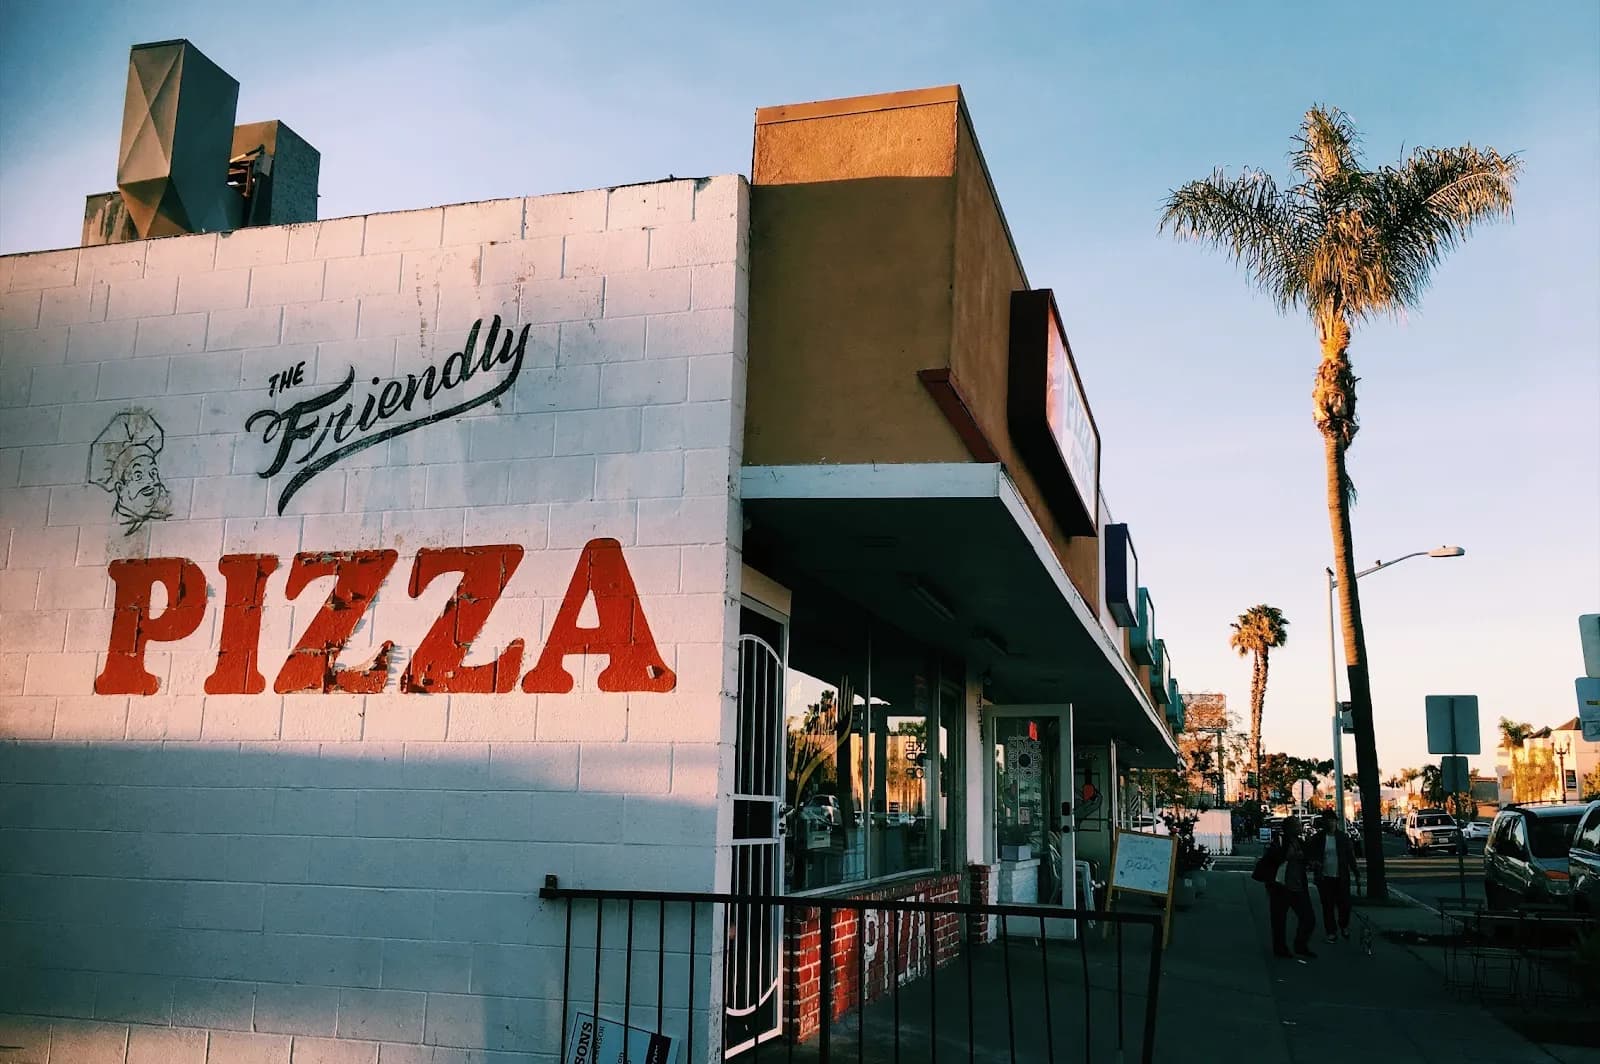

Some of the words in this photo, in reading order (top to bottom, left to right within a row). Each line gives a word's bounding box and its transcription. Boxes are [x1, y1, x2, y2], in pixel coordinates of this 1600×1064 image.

[245, 314, 532, 516] Friendly
[268, 361, 304, 397] THE
[94, 537, 678, 696] PIZZA
